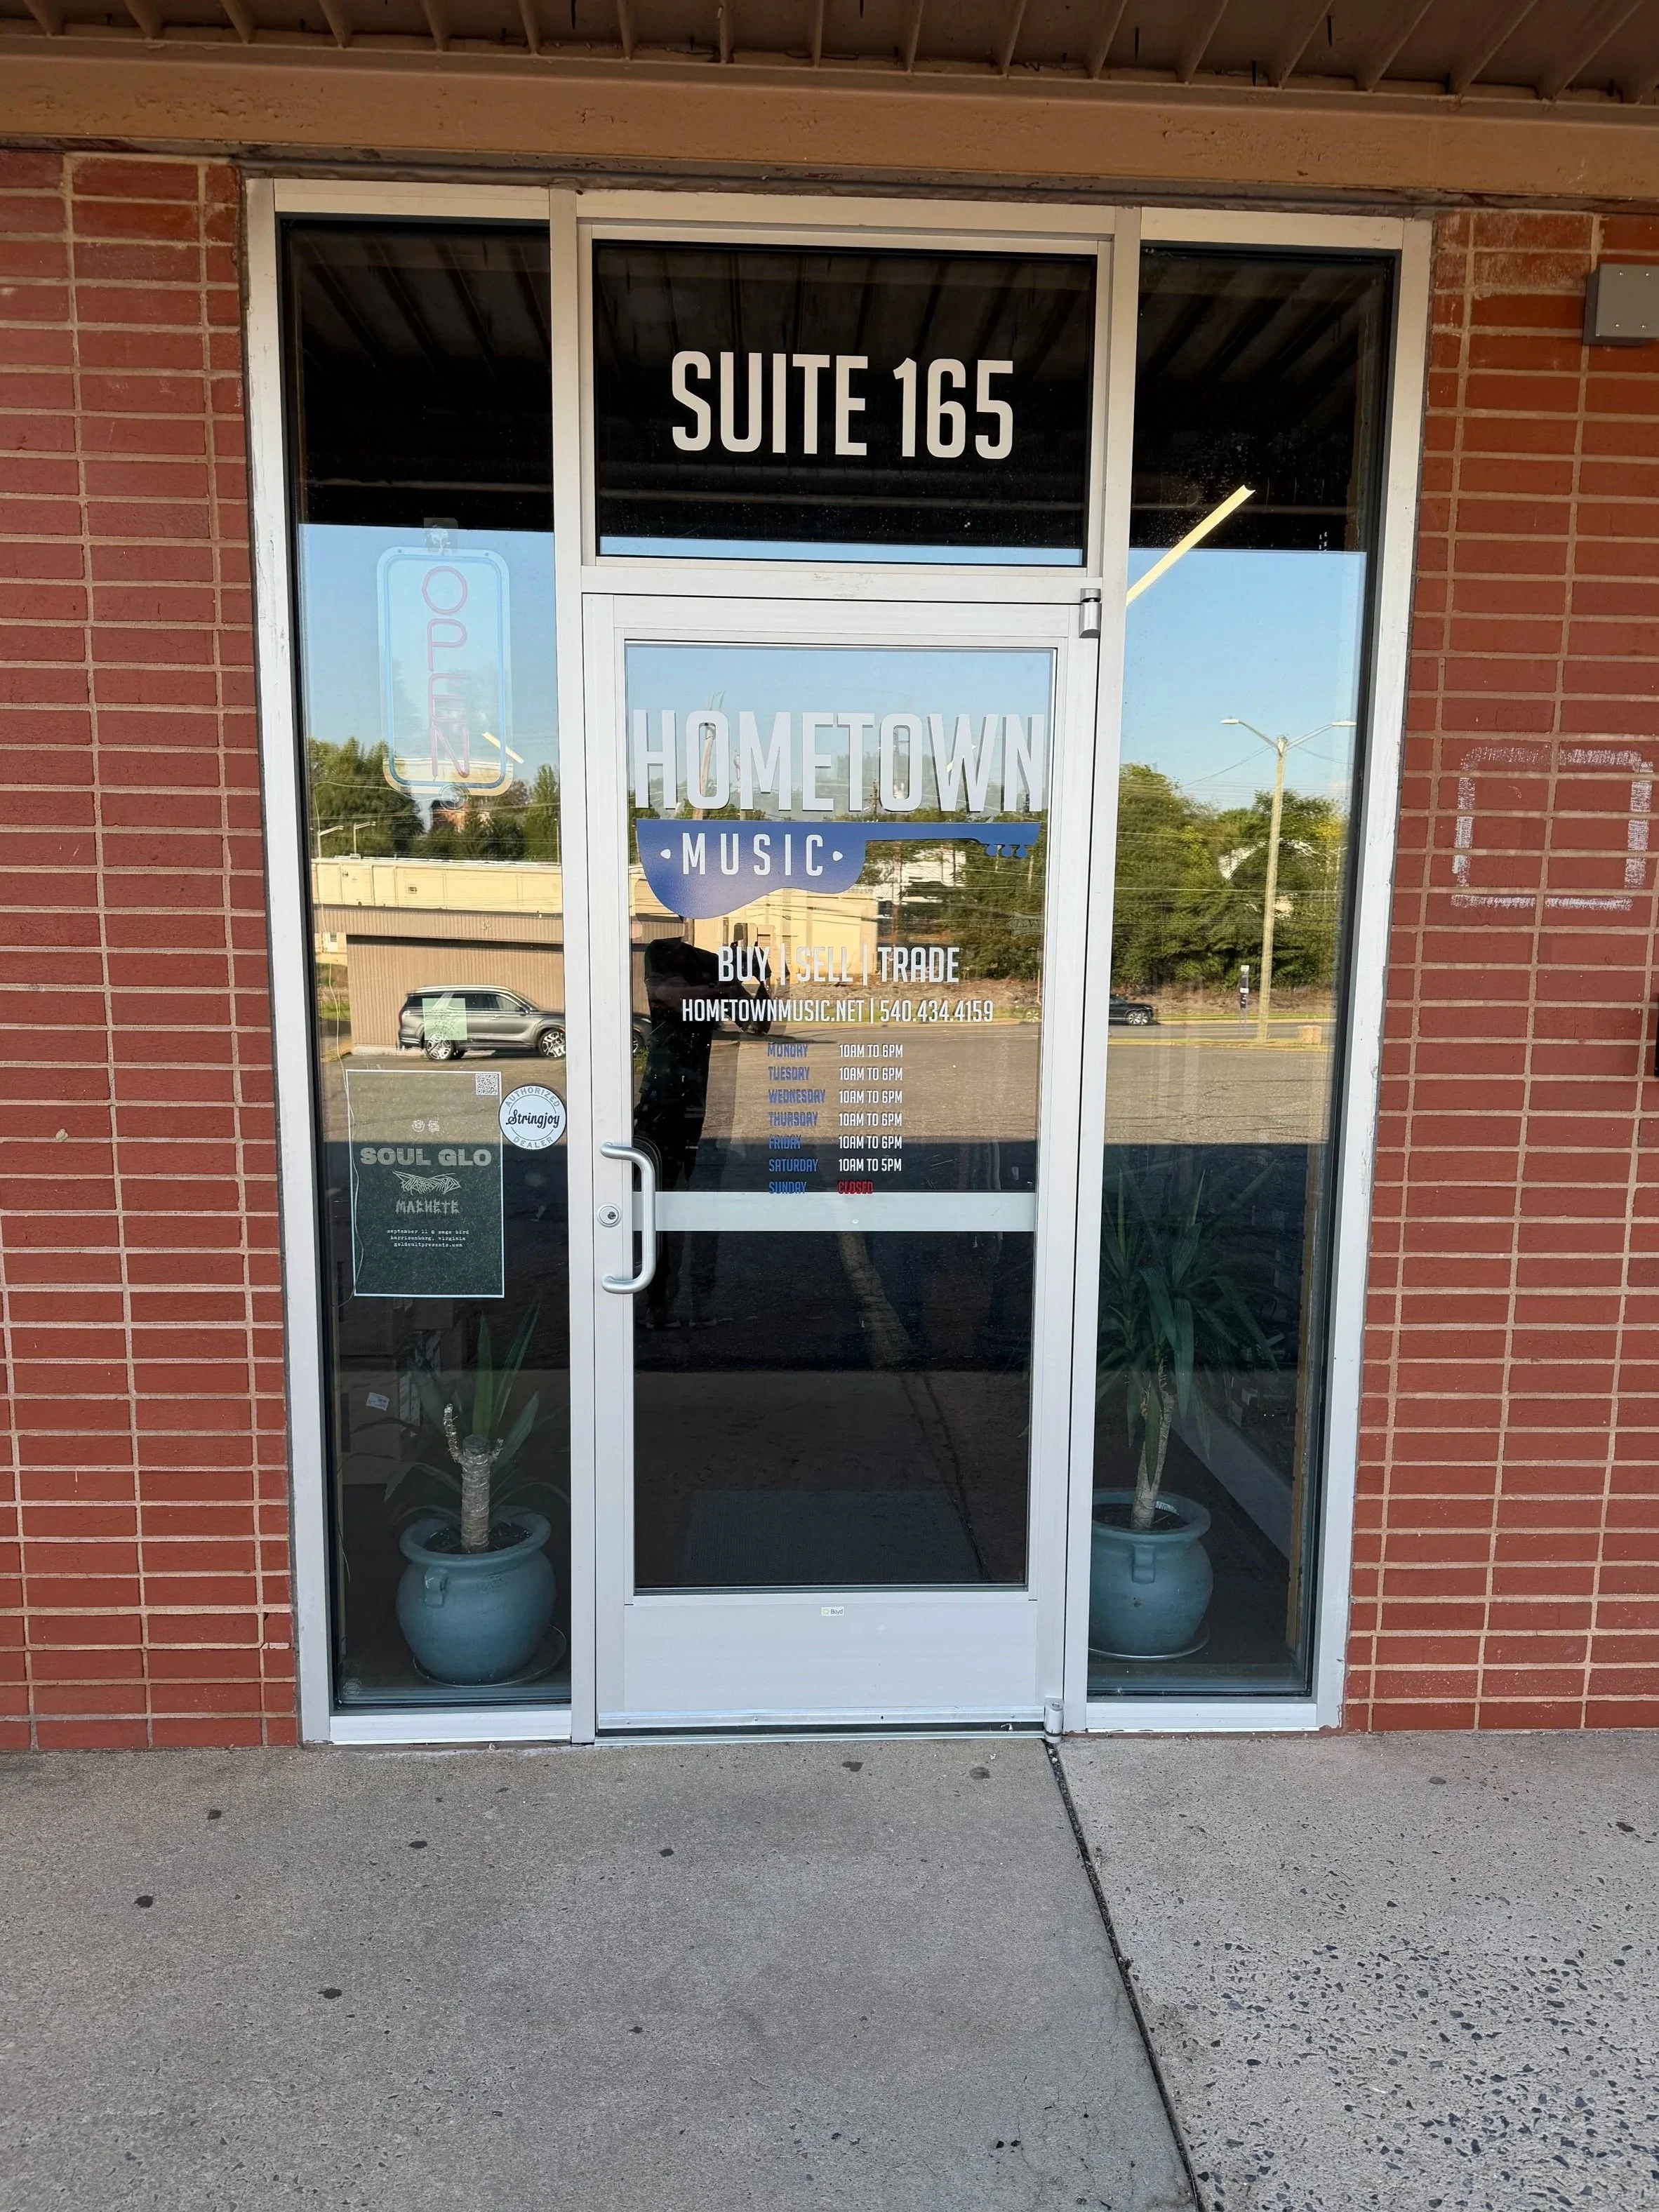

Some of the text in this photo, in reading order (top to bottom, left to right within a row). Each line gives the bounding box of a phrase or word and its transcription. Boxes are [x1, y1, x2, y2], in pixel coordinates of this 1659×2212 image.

[672, 351, 1013, 459] SUITE 165
[422, 566, 470, 781] OPEN
[633, 709, 1044, 812] HOMETOWN
[682, 832, 825, 877] MUSIC
[718, 946, 768, 982] BUY
[796, 947, 853, 982] SELL
[877, 947, 960, 982] TRADE
[682, 999, 864, 1022] HOMETOWNMUSIC.NET
[879, 999, 994, 1022] 540.434.4159
[767, 1044, 902, 1058] MONDAY 10AM TO 6PM
[768, 1067, 902, 1081] TUESDAY 10AM TO 6PM
[505, 1086, 560, 1107] AUTHORIZED
[768, 1089, 902, 1103] WEDNESDAY 10AM TO 6PM
[505, 1109, 560, 1129] Stringjoy
[768, 1112, 902, 1126] THURSDAY 10AM TO 6PM
[513, 1136, 554, 1148] DEALER
[769, 1135, 902, 1150] FRIDAY 10AM TO 6PM
[360, 1147, 492, 1166] SOUL GLO
[769, 1159, 902, 1173] SATURDAY 10AM TO 5PM
[769, 1181, 873, 1194] SUNDAY CLOSED
[395, 1199, 460, 1215] MACHETE
